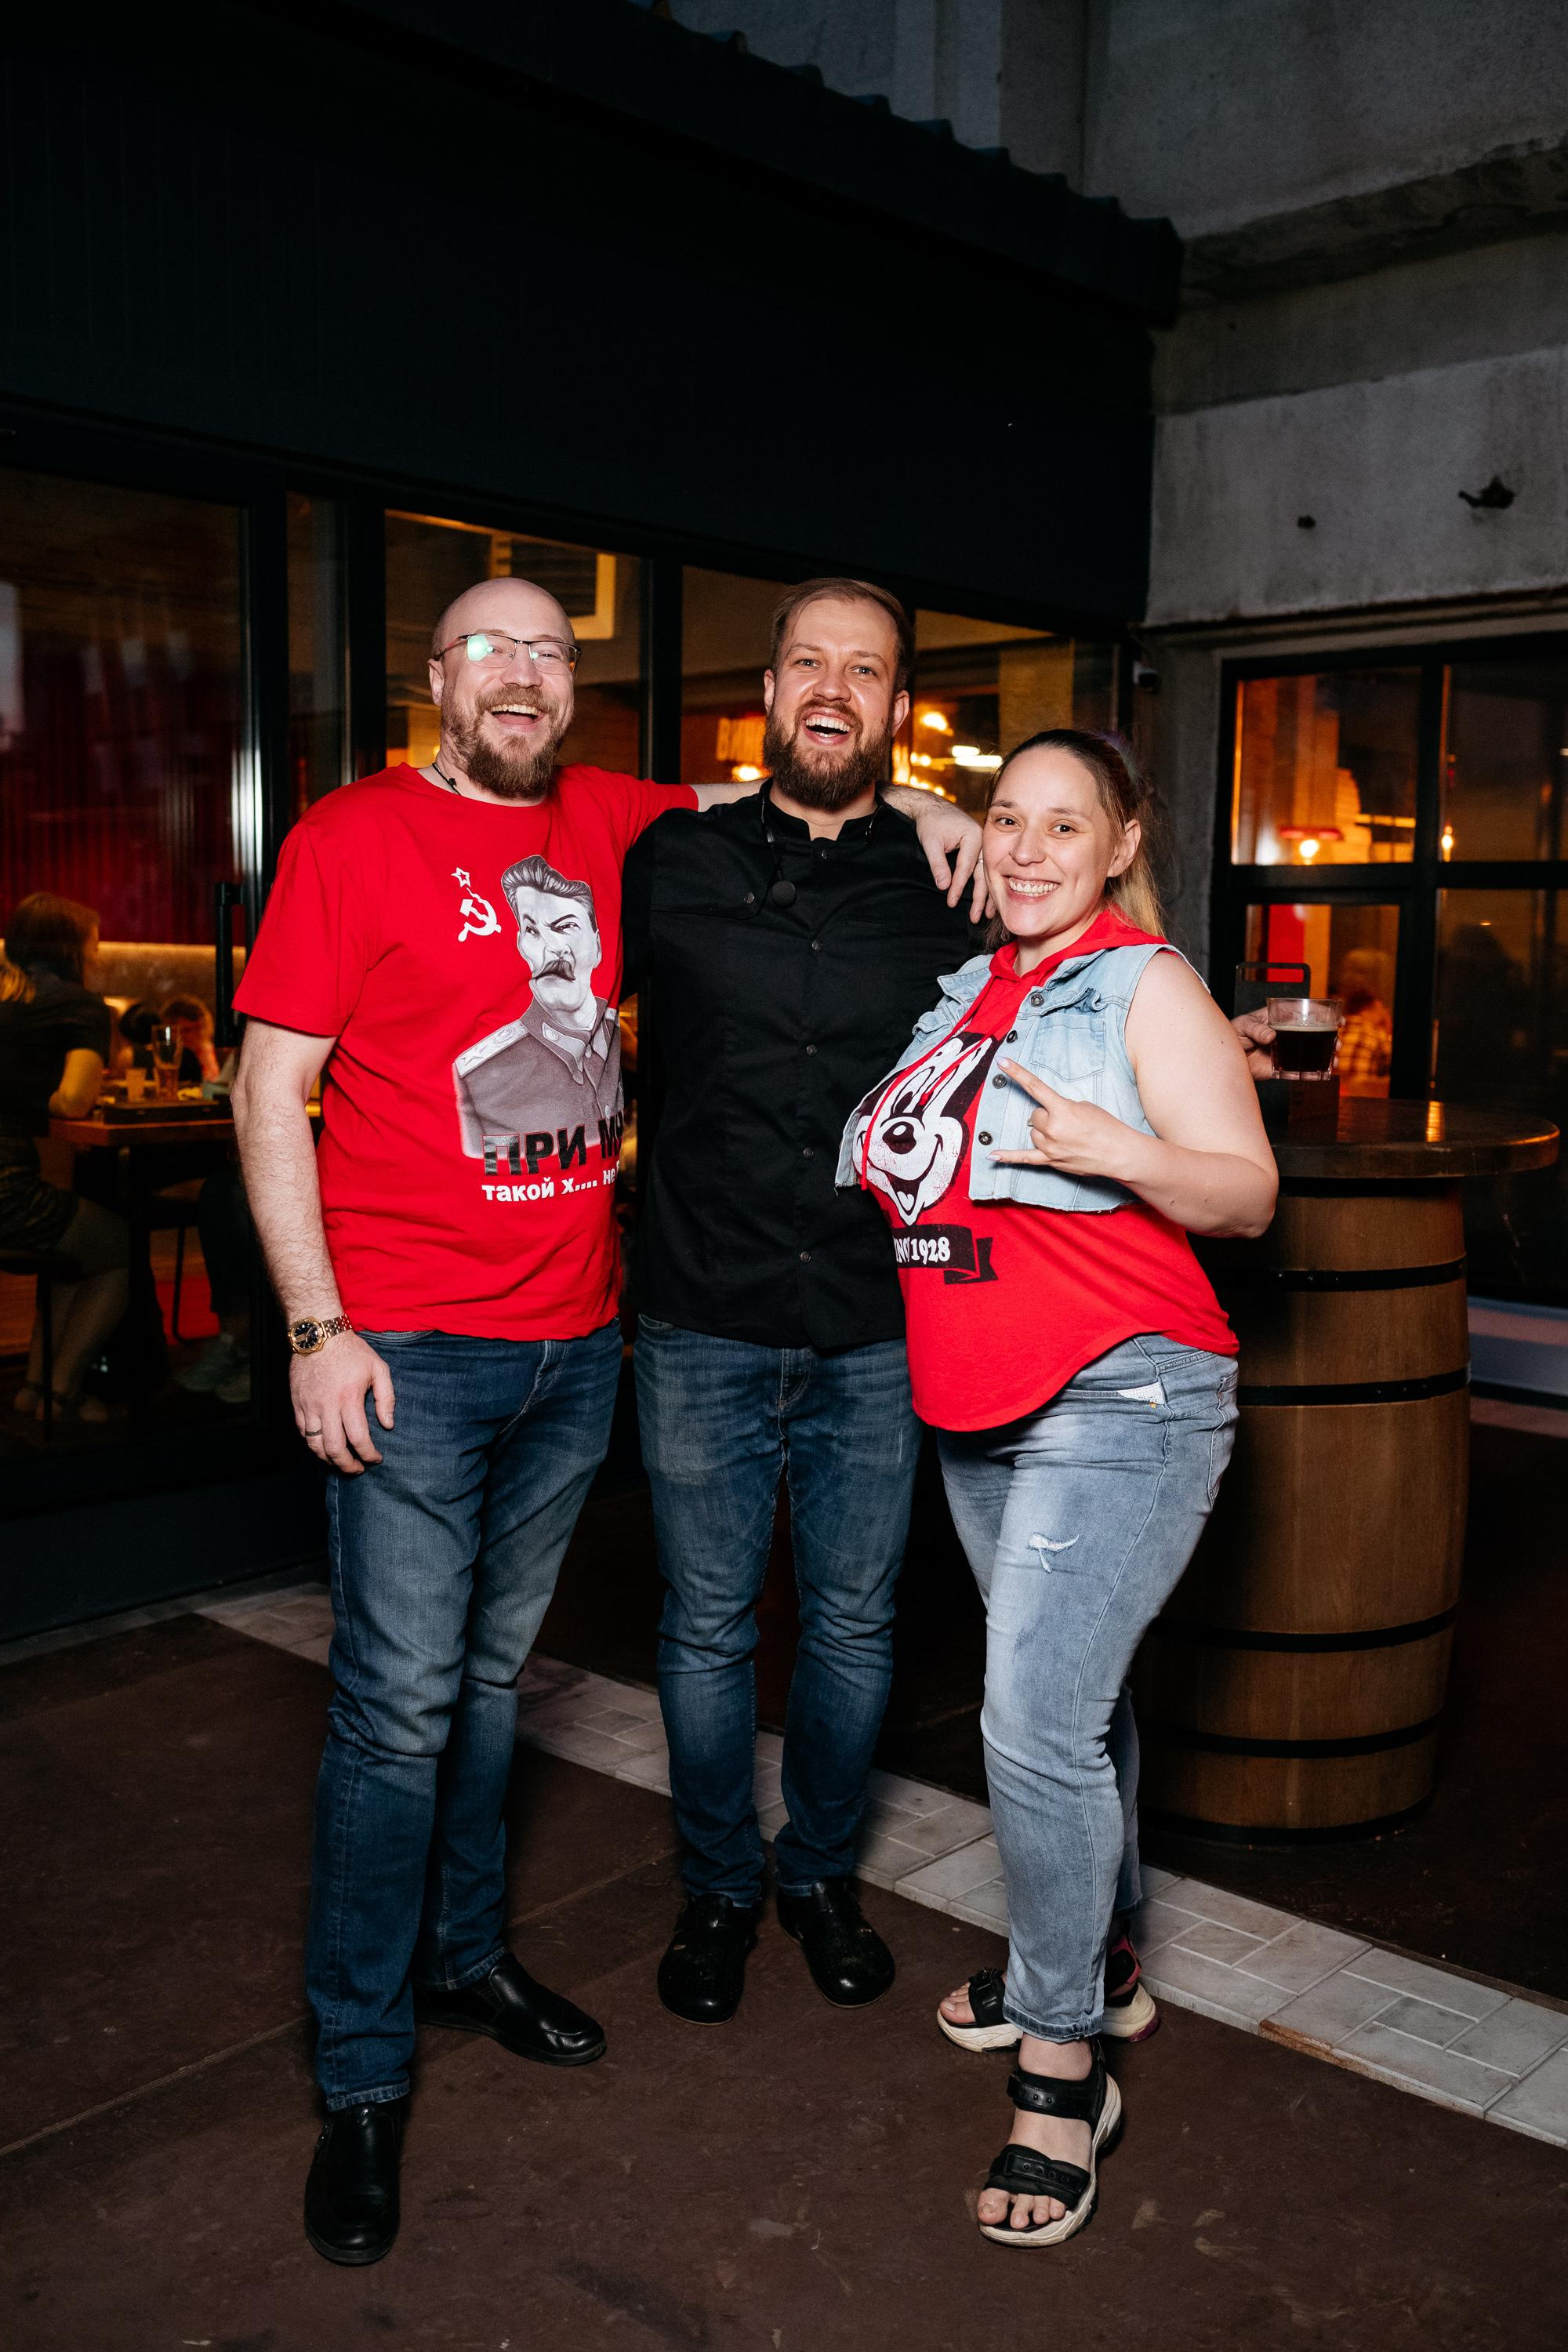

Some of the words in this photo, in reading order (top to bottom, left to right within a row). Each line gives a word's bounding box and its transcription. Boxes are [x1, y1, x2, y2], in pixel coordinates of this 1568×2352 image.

[481, 1124, 586, 1175] ПРИ
[597, 1110, 623, 1159] МН
[481, 1177, 554, 1202] такой
[910, 1236, 950, 1265] 1928
